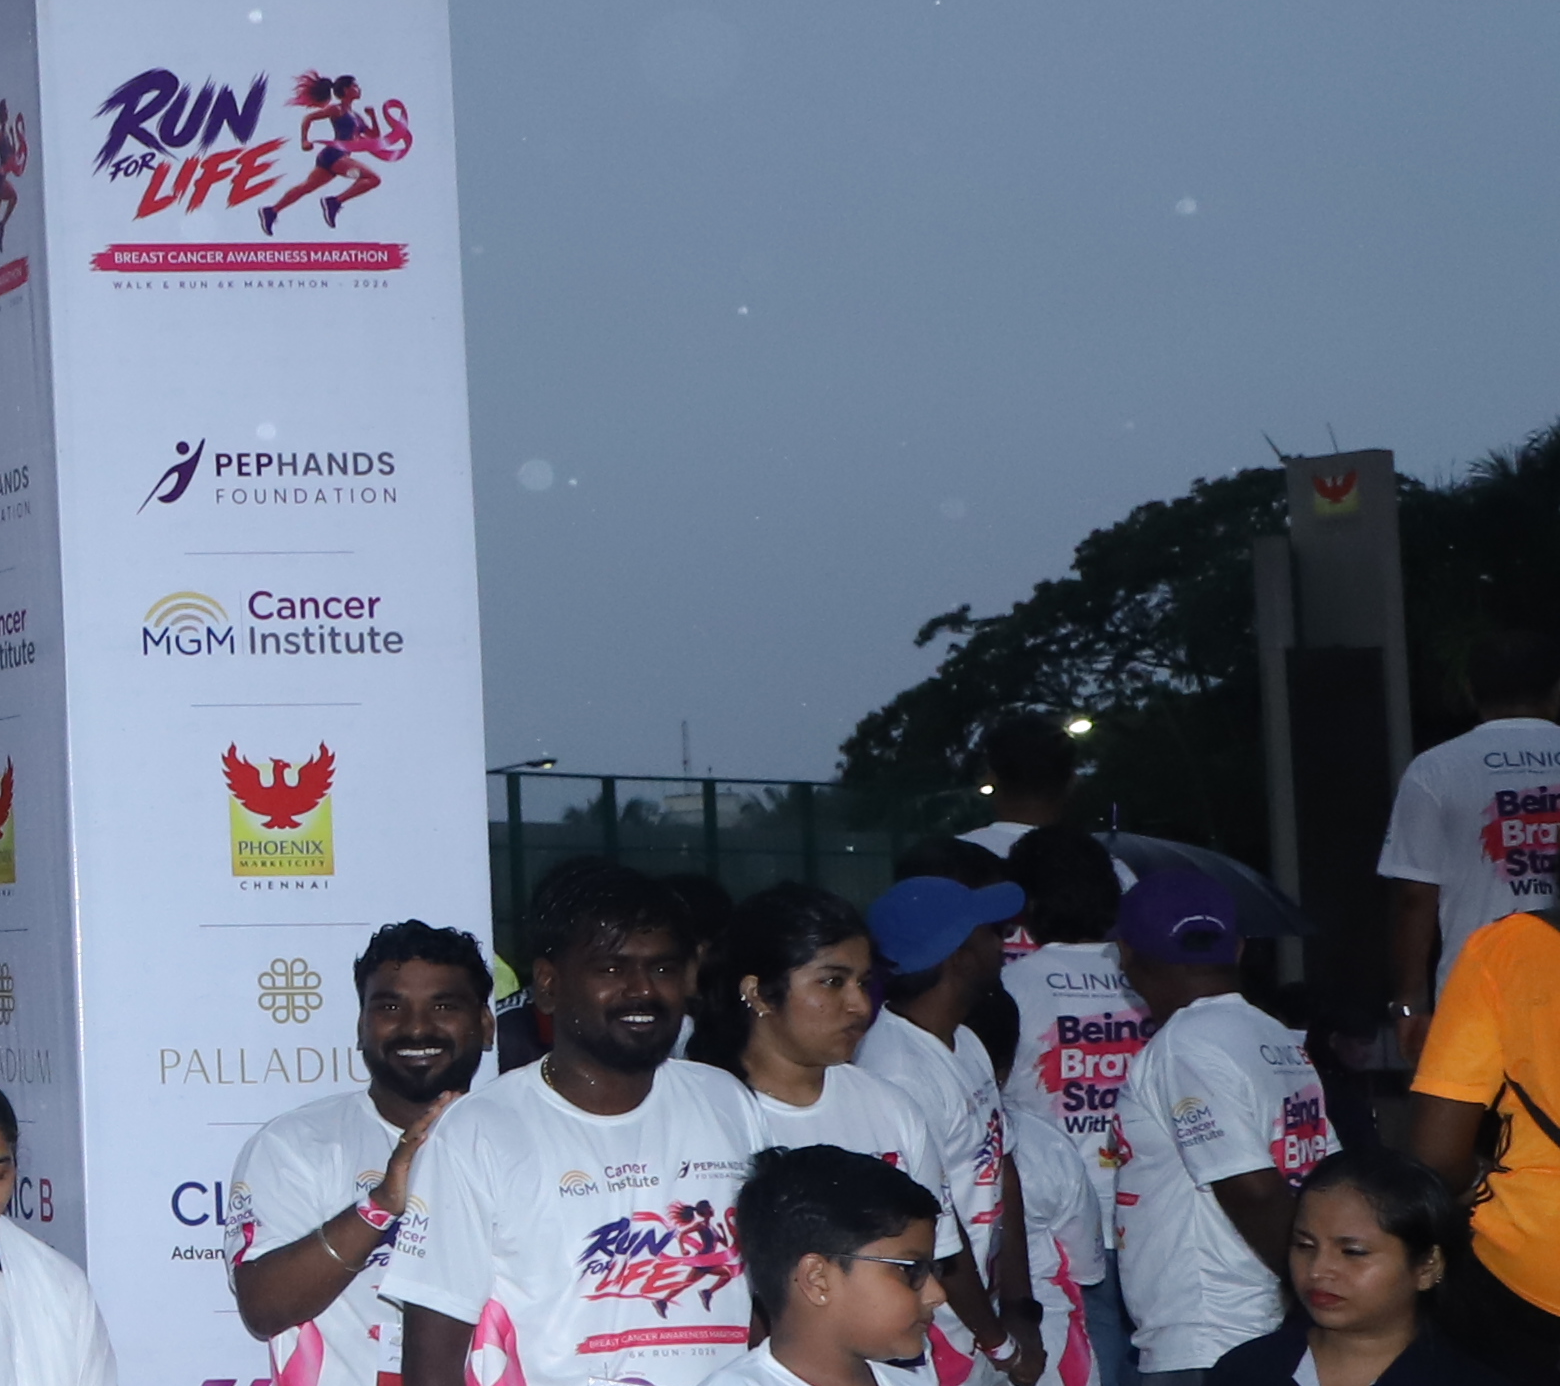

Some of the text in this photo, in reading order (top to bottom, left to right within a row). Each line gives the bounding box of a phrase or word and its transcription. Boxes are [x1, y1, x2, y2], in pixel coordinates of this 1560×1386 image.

[92, 68, 269, 176] RUN
[109, 137, 291, 221] FOR LIFE
[114, 249, 388, 265] BREAST CANCER AWARENESS MARATHON
[113, 281, 152, 289] WALK
[180, 281, 208, 289] RUN
[244, 280, 328, 288] MARATHON
[215, 452, 396, 477] PEPHANDS
[216, 488, 397, 504] FOUNDATION
[248, 591, 381, 620] Cancer
[142, 625, 404, 656] MGM Institute
[238, 840, 324, 855] PHOENIX
[239, 859, 326, 868] MARKETCITY
[240, 880, 329, 890] CHENNAI
[1057, 1013, 1160, 1045] Being
[161, 1046, 373, 1084] PALLADIU
[559, 1183, 598, 1197] MGM
[577, 1217, 678, 1264] RUN
